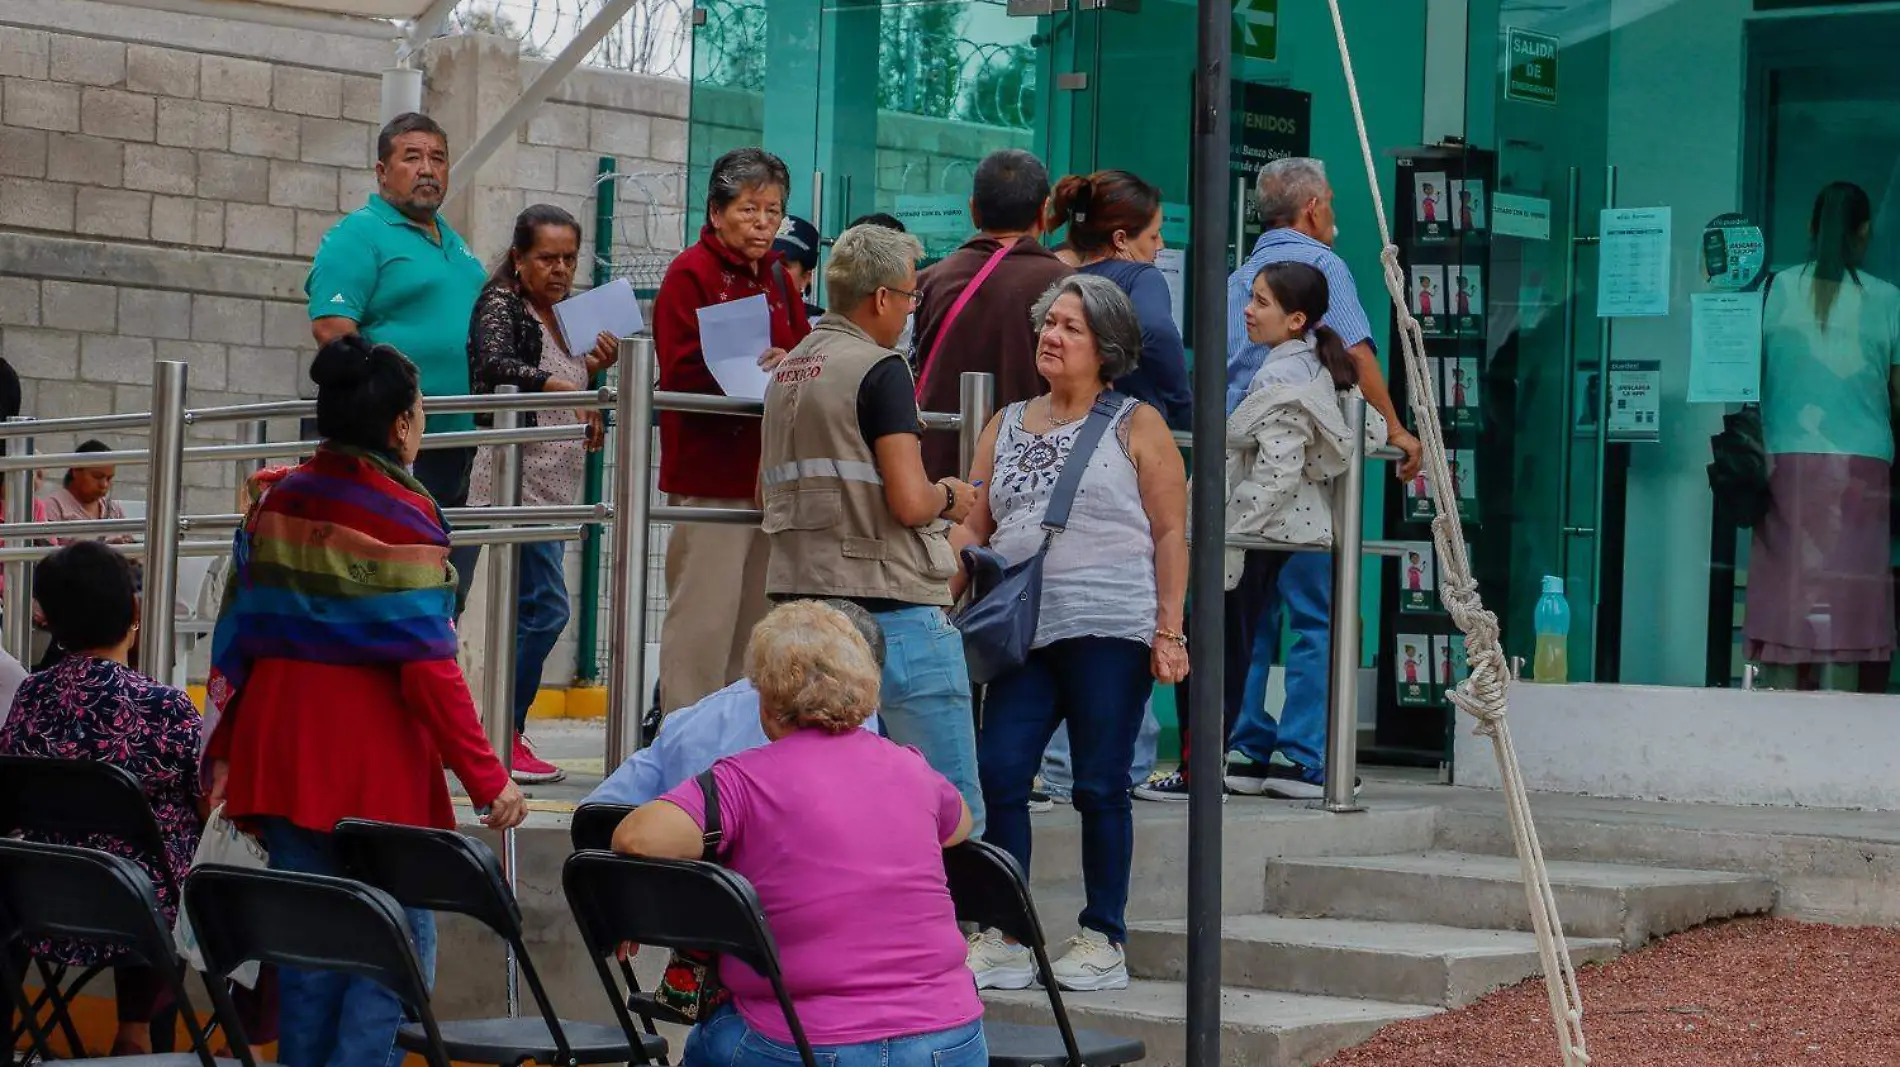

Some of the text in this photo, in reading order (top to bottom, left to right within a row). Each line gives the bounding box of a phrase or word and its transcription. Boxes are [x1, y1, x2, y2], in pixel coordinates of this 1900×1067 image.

[1513, 39, 1555, 59] SALIDA
[1526, 63, 1541, 79] DE
[1242, 144, 1266, 159] Banco
